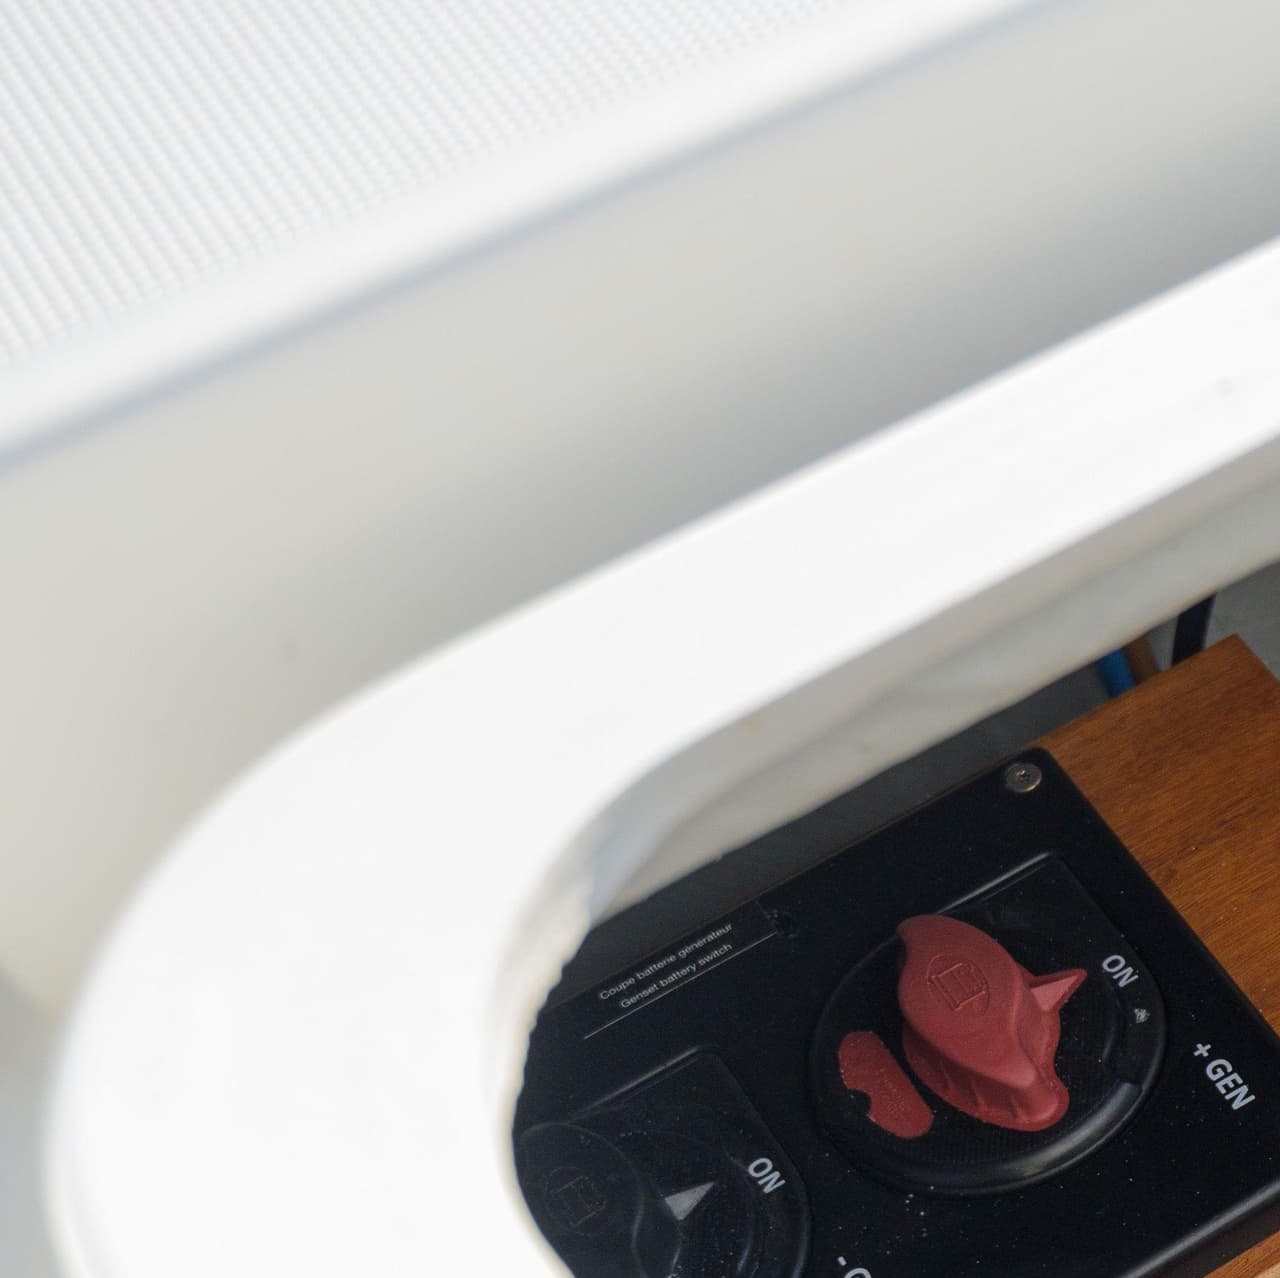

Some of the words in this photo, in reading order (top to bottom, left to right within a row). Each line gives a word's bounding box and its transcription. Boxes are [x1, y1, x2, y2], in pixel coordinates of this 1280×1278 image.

[598, 976, 636, 1000] Coupe
[634, 953, 677, 980] batterie
[617, 982, 660, 1008] Genset
[657, 962, 697, 988] battery
[696, 942, 733, 967] switch
[1101, 954, 1139, 988] ON
[1205, 1058, 1256, 1111] GEN
[747, 1157, 786, 1194] ON
